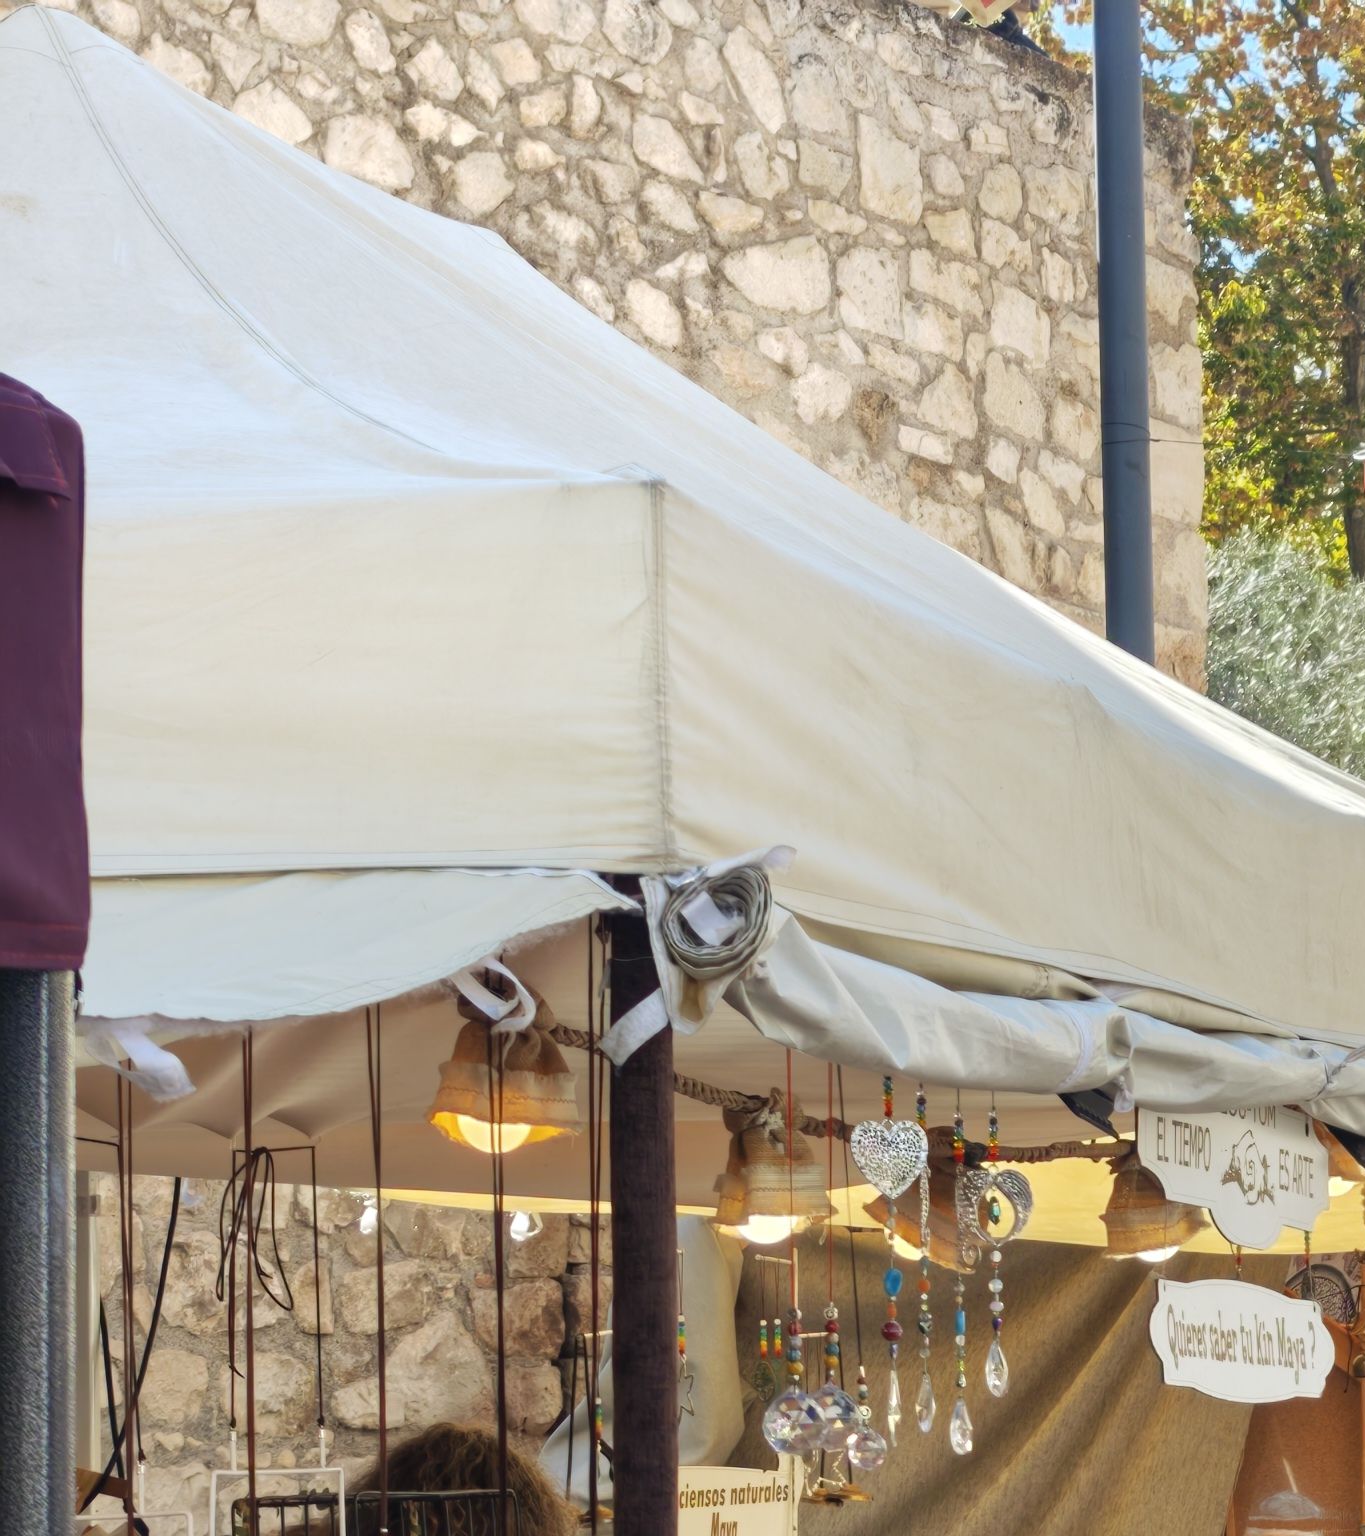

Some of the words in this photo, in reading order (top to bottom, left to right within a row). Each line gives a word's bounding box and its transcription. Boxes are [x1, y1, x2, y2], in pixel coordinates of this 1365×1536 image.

[1156, 1116, 1169, 1163] EL
[1172, 1120, 1212, 1172] TIEMPO
[1279, 1148, 1290, 1192] ES
[1292, 1152, 1314, 1199] ARTE
[1167, 1304, 1208, 1370] Quieres
[1209, 1310, 1238, 1363] saber
[1240, 1313, 1254, 1365] tu
[1255, 1313, 1275, 1367] Kin
[1276, 1317, 1307, 1385] Maya
[1308, 1320, 1316, 1369] ?
[679, 1483, 726, 1509] ciensos
[730, 1476, 789, 1506] naturales
